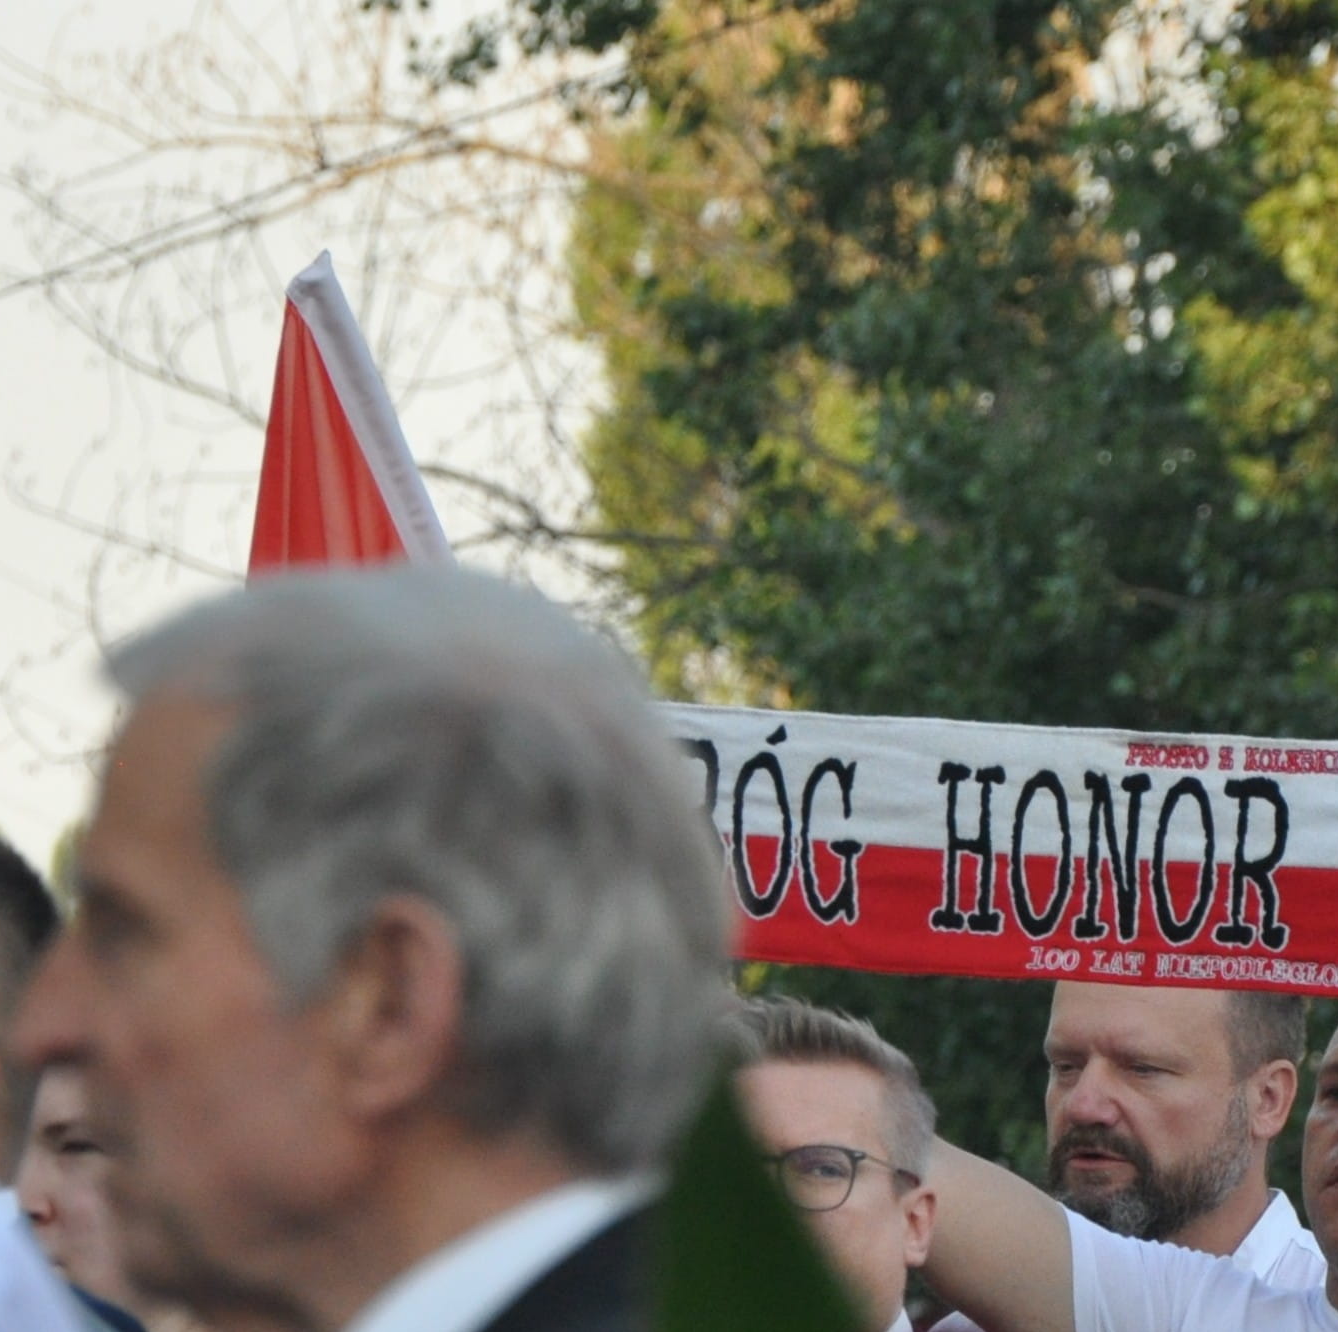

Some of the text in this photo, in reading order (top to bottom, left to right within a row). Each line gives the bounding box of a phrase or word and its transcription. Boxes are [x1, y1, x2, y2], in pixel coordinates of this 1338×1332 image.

[1125, 742, 1209, 770] PROSTO
[1218, 746, 1234, 770] Z
[930, 761, 1290, 949] HONOR
[1026, 946, 1081, 971] 100
[1089, 950, 1144, 975] LAT
